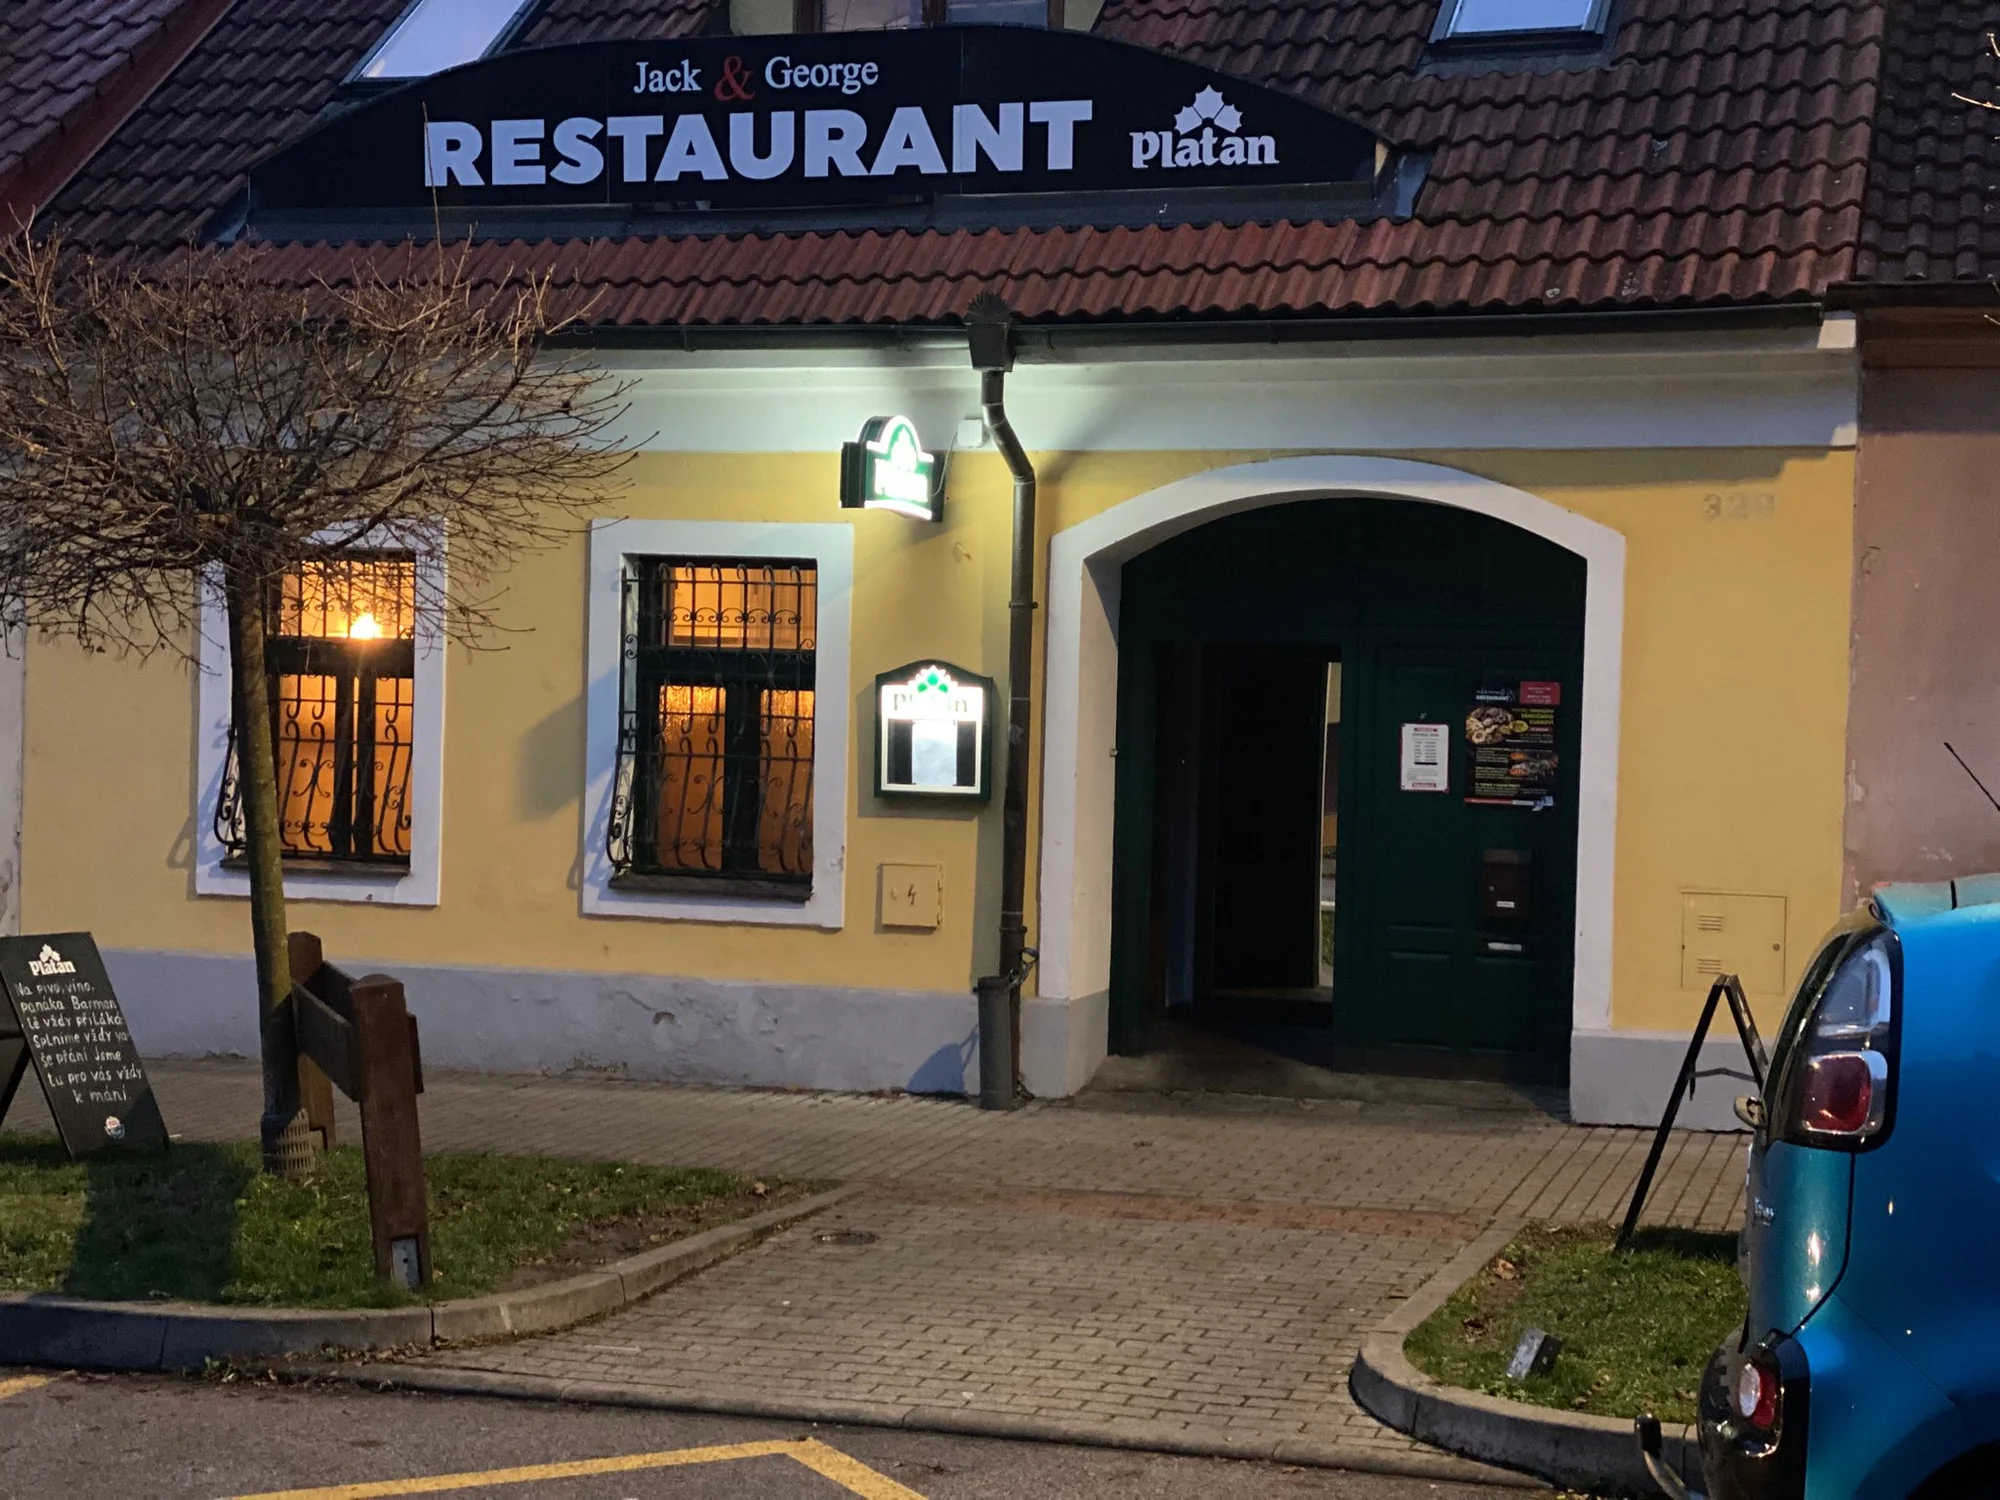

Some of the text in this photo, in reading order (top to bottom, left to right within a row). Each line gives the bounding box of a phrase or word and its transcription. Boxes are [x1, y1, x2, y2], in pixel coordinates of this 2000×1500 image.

[633, 54, 879, 101] Jack & George
[423, 99, 1094, 187] RESTAURANT
[20, 994, 118, 1014] panáka Barman
[68, 1071, 87, 1085] pro
[72, 1089, 84, 1105] k
